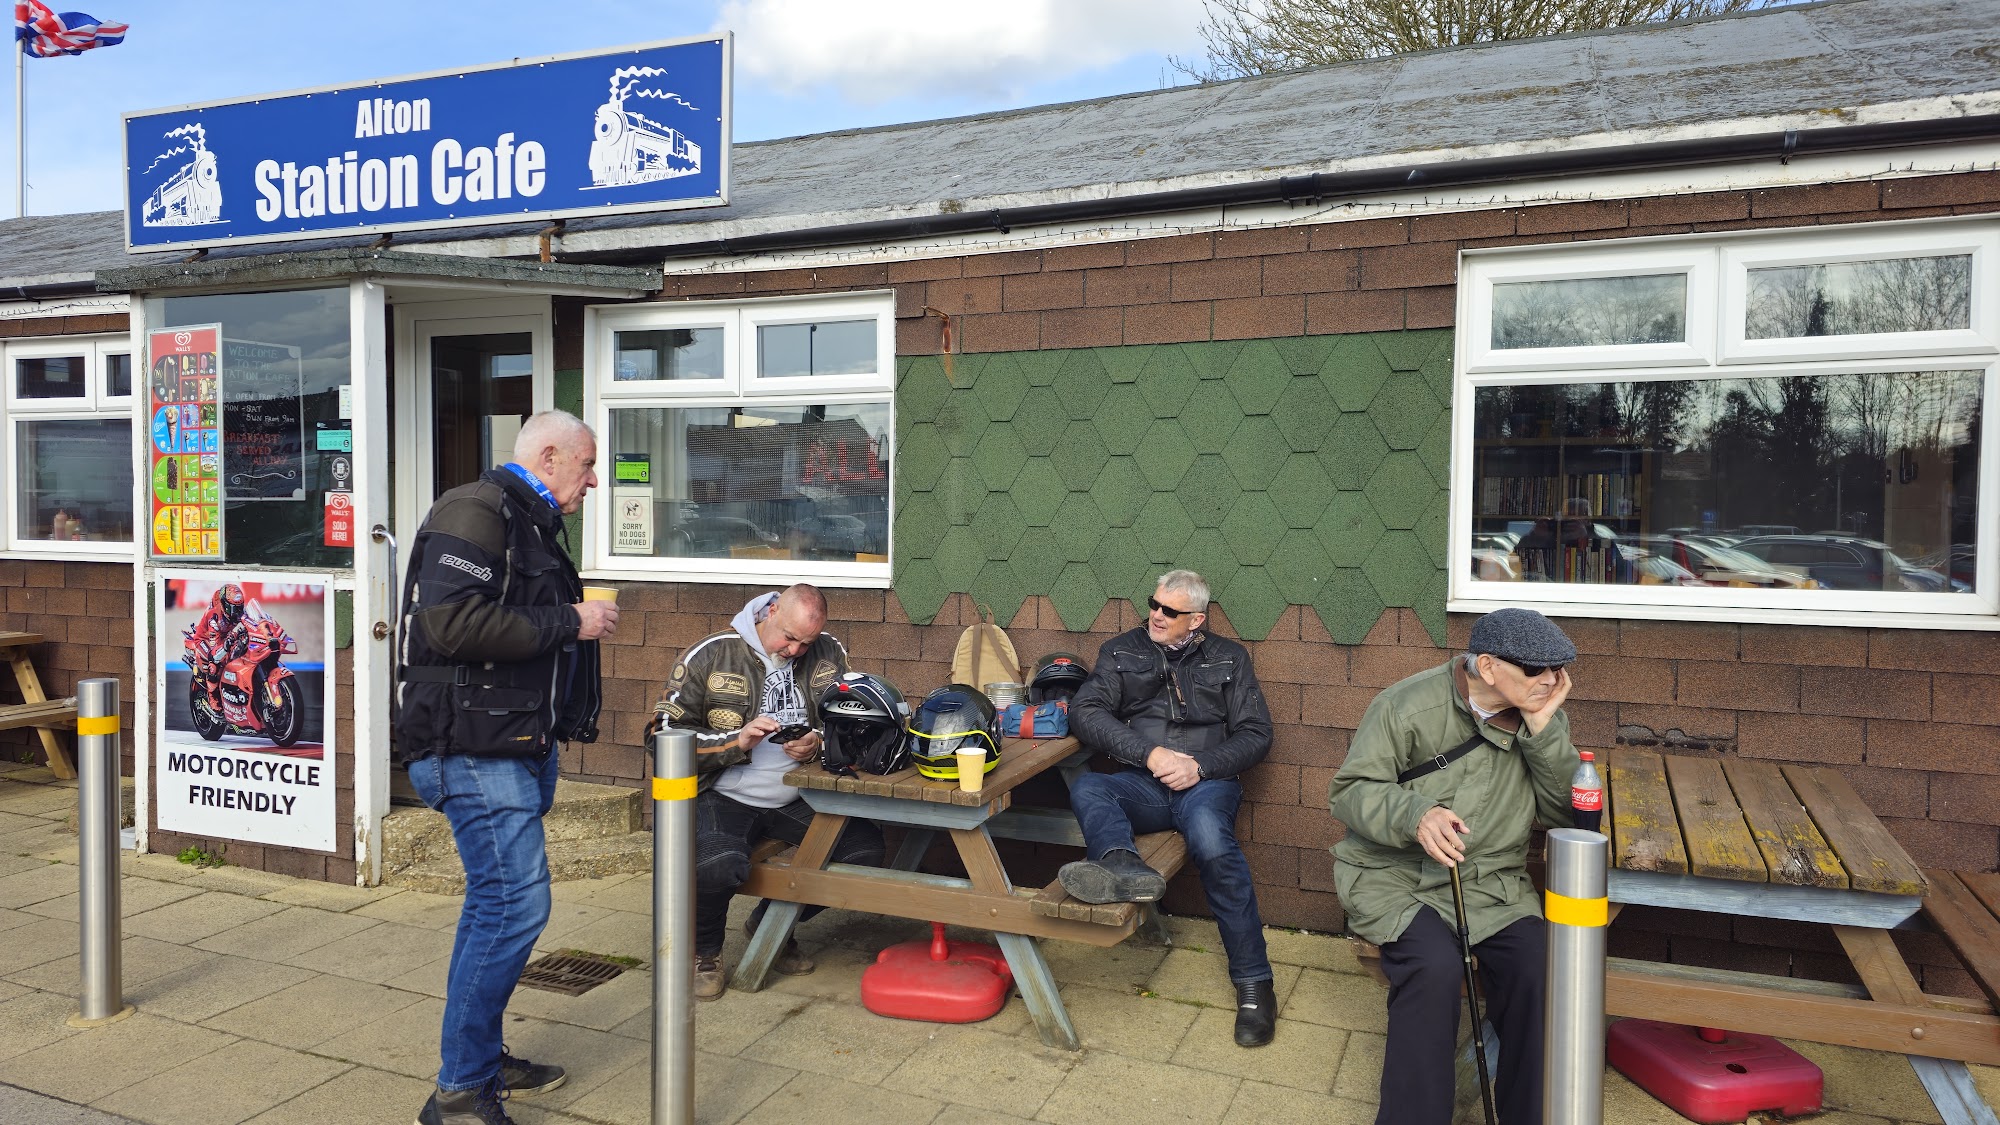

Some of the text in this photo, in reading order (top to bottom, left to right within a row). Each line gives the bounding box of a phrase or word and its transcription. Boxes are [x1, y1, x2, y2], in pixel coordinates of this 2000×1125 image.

[355, 96, 431, 139] Alton
[255, 132, 546, 222] Station Cafe
[229, 345, 278, 359] WELCOME
[235, 359, 249, 369] TO
[222, 368, 258, 381] TATION
[235, 393, 254, 401] OPEN
[223, 404, 239, 412] MON
[803, 437, 886, 484] ALL
[332, 520, 347, 531] SOLD
[618, 538, 647, 546] ALLOWED
[168, 752, 320, 787] MOTORCYCLE
[189, 784, 297, 816] FRIENDLY
